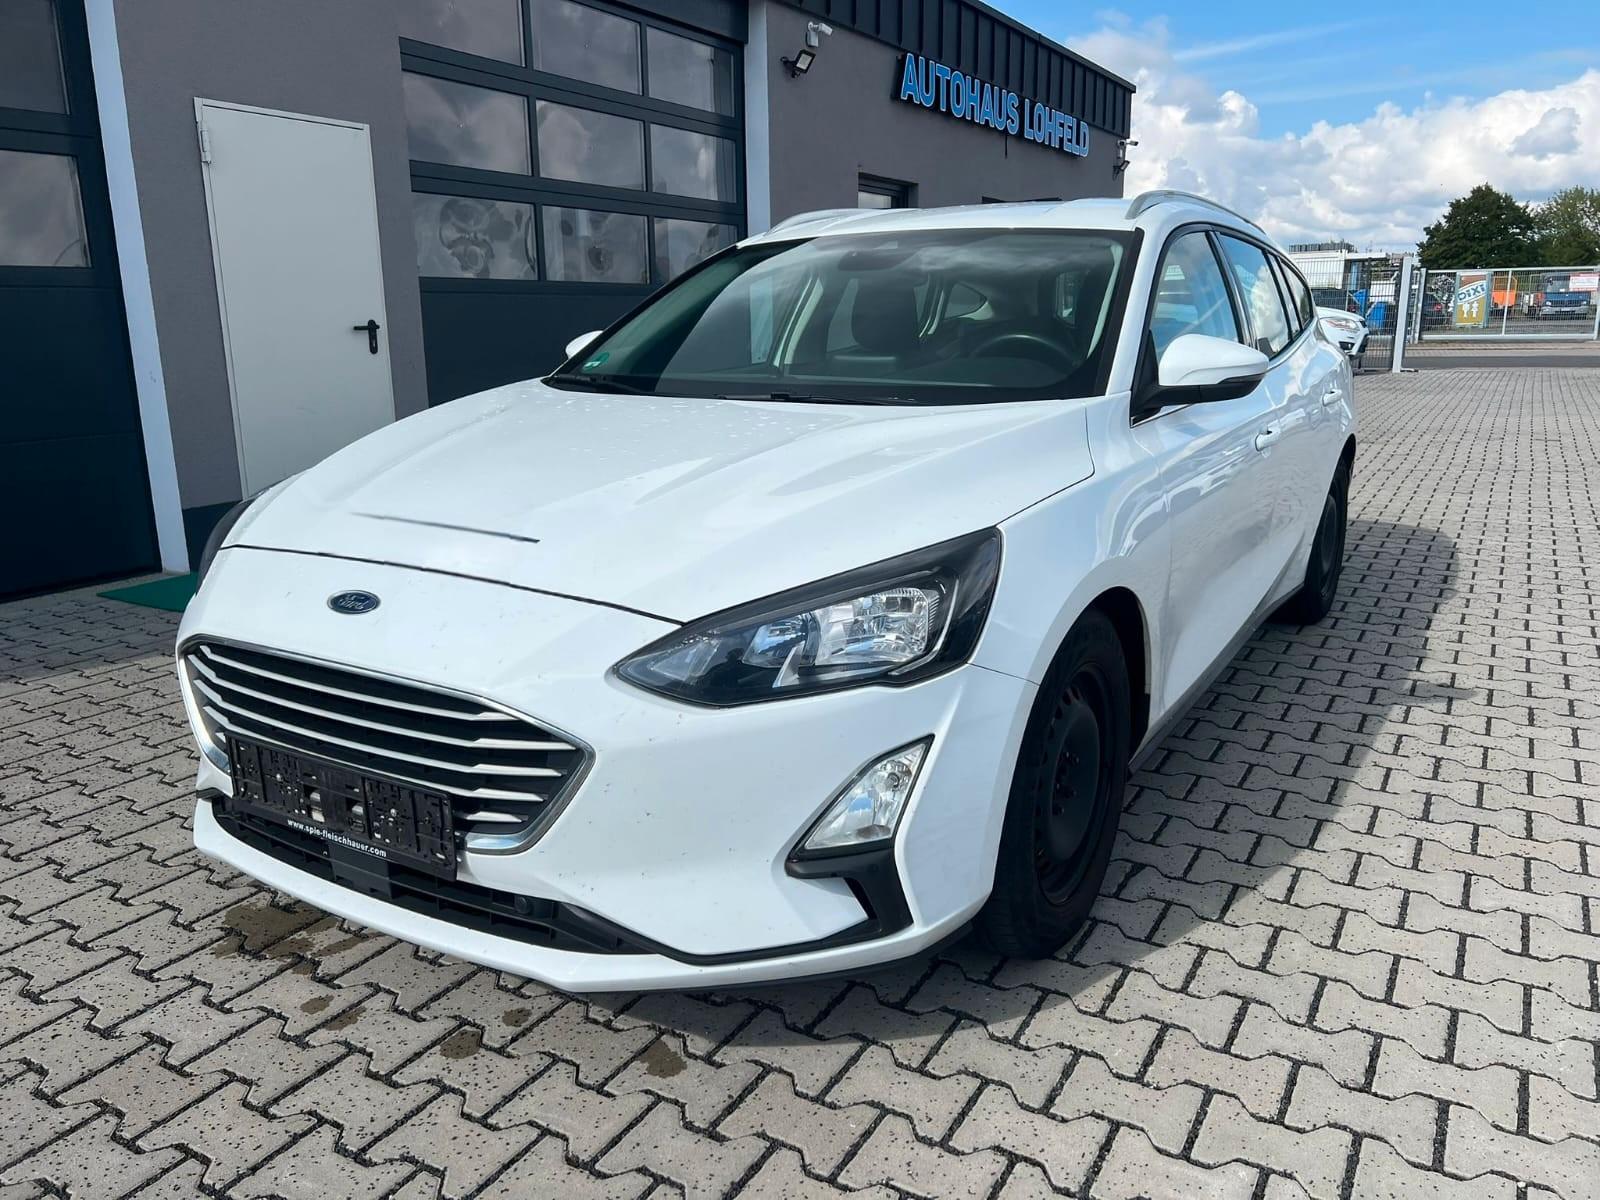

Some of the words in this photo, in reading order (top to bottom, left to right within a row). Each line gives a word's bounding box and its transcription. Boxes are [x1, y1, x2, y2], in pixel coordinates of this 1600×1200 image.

[900, 53, 1020, 135] AUTOHAUS
[1024, 98, 1090, 158] LOHFELD
[338, 595, 369, 609] Ford
[287, 819, 387, 858] www.spie-fleischhauer.com
